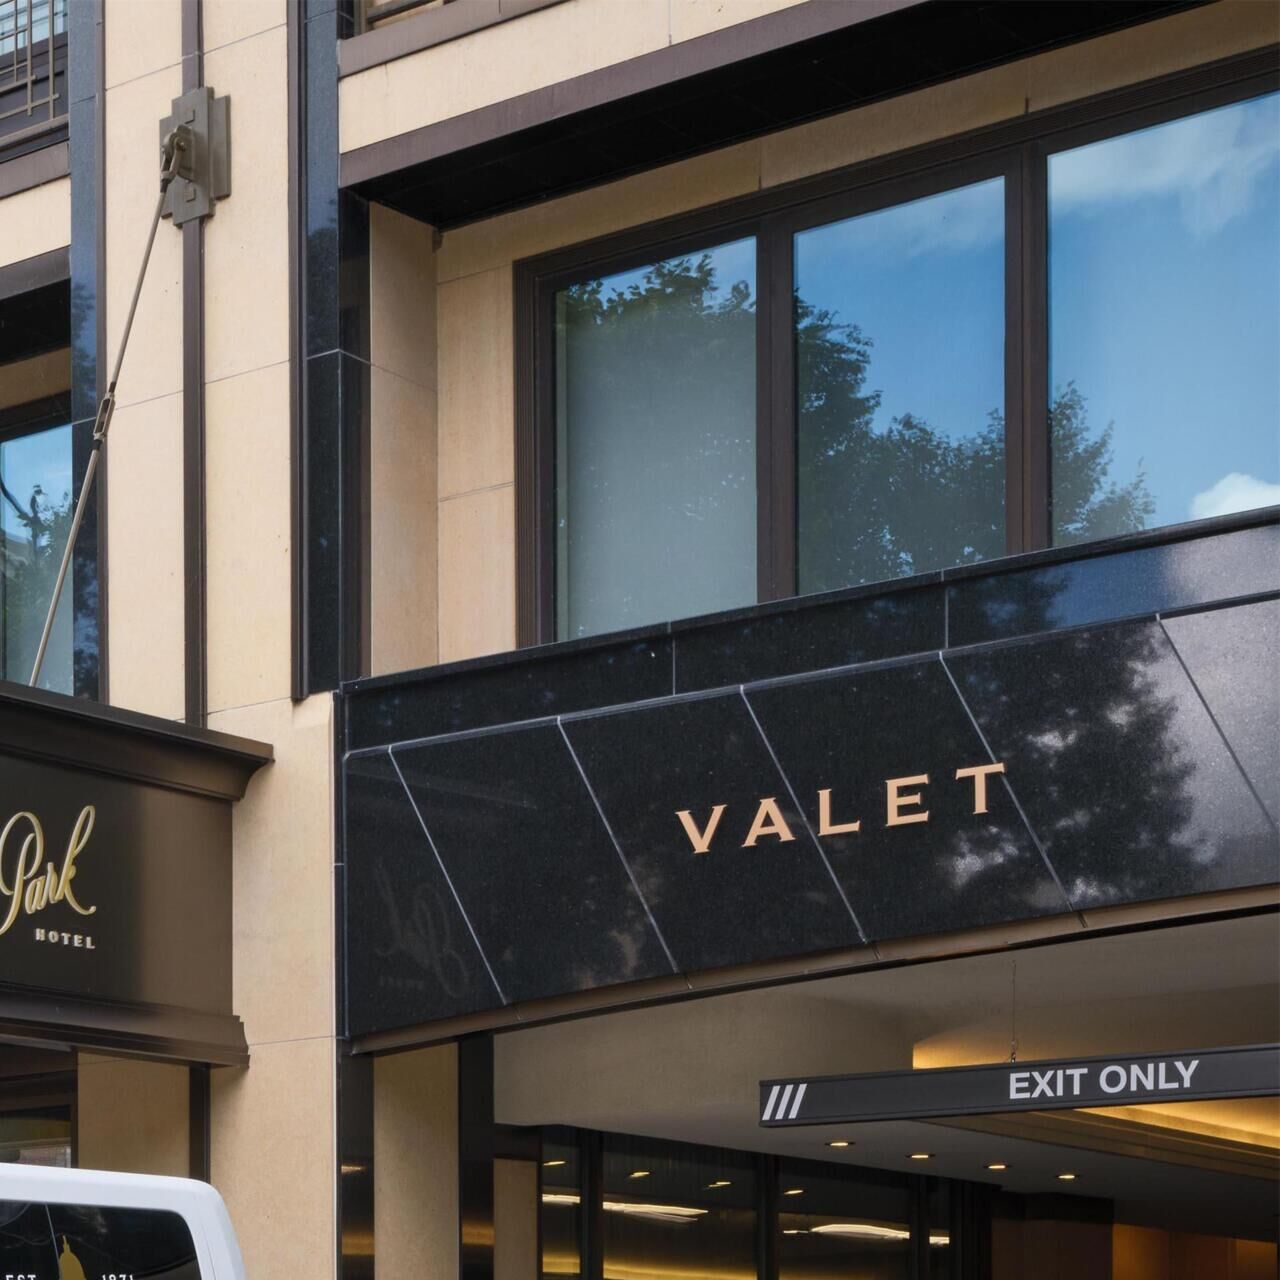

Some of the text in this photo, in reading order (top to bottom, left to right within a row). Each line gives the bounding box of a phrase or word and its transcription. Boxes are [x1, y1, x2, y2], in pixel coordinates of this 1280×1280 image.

[675, 762, 1005, 854] VALET
[35, 928, 96, 950] HOTEL
[1009, 1060, 1200, 1100] EXIT ONLY
